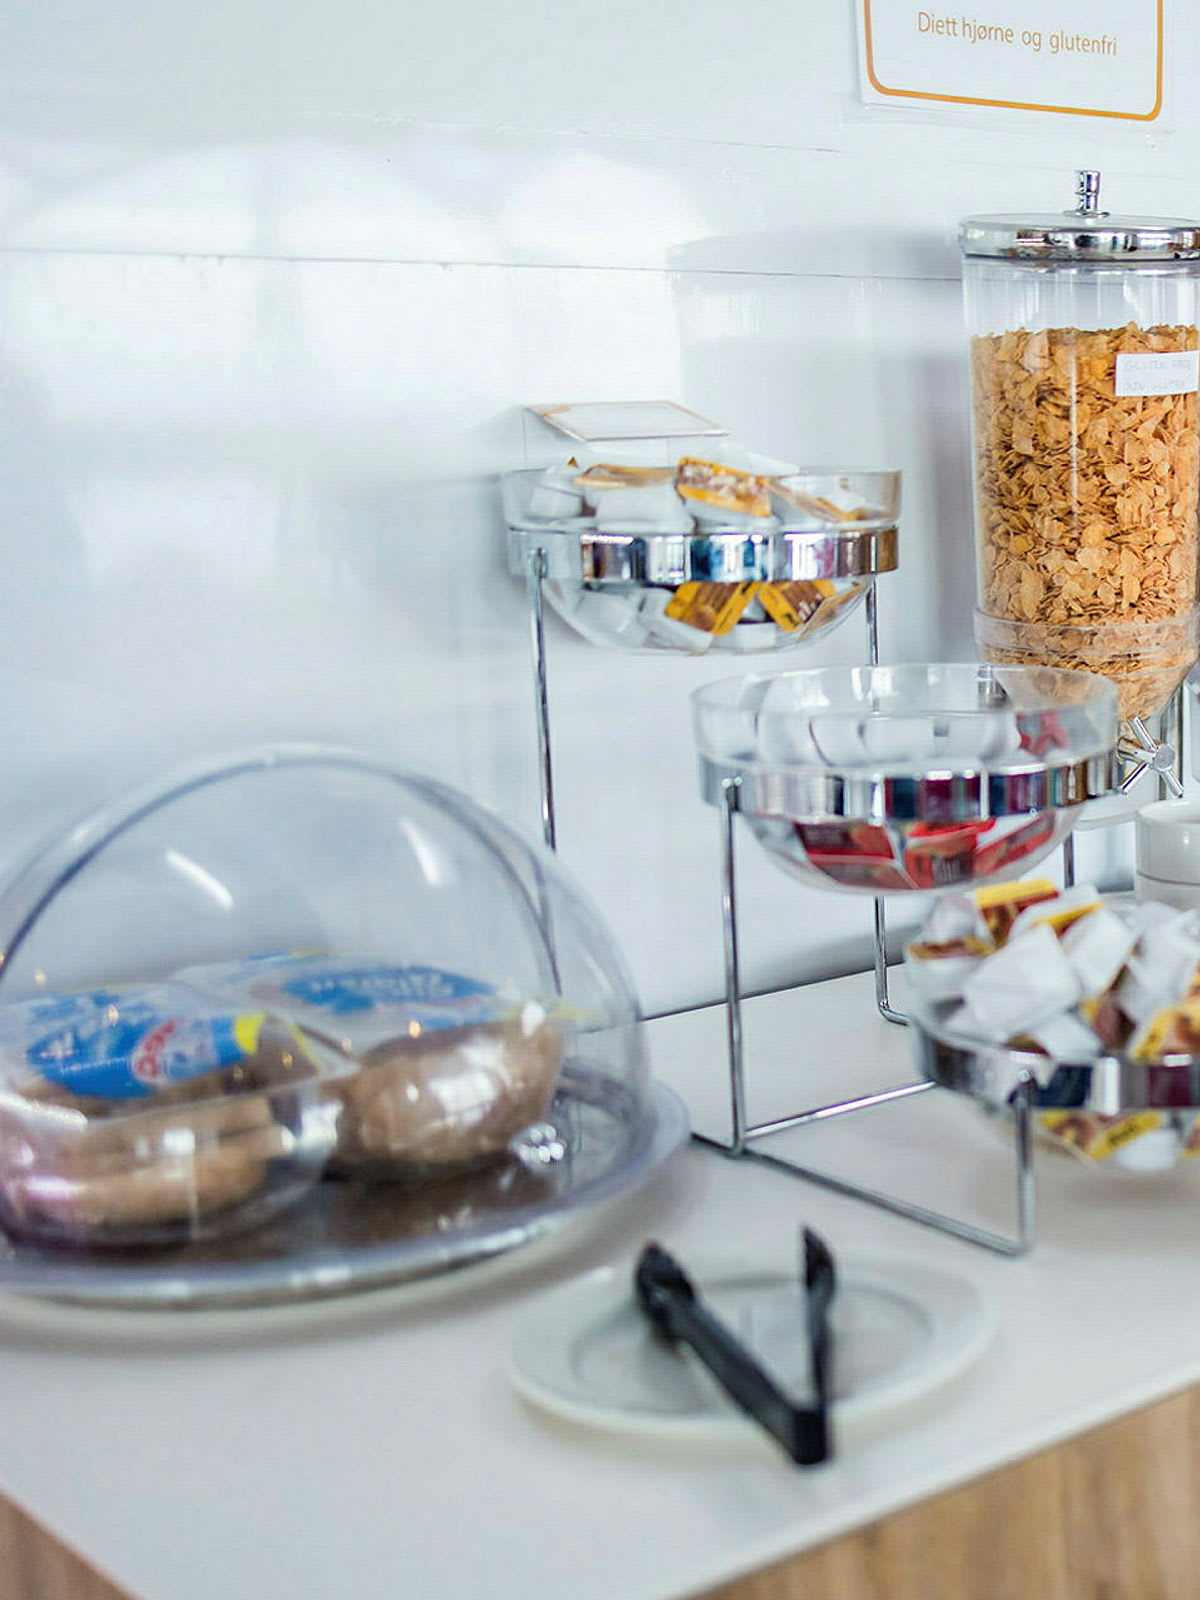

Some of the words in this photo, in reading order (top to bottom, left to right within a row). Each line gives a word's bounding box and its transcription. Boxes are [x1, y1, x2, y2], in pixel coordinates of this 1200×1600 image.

[918, 12, 957, 37] Diett
[962, 17, 1014, 43] hjørne
[1021, 30, 1042, 51] og
[1049, 30, 1117, 56] glutenfri
